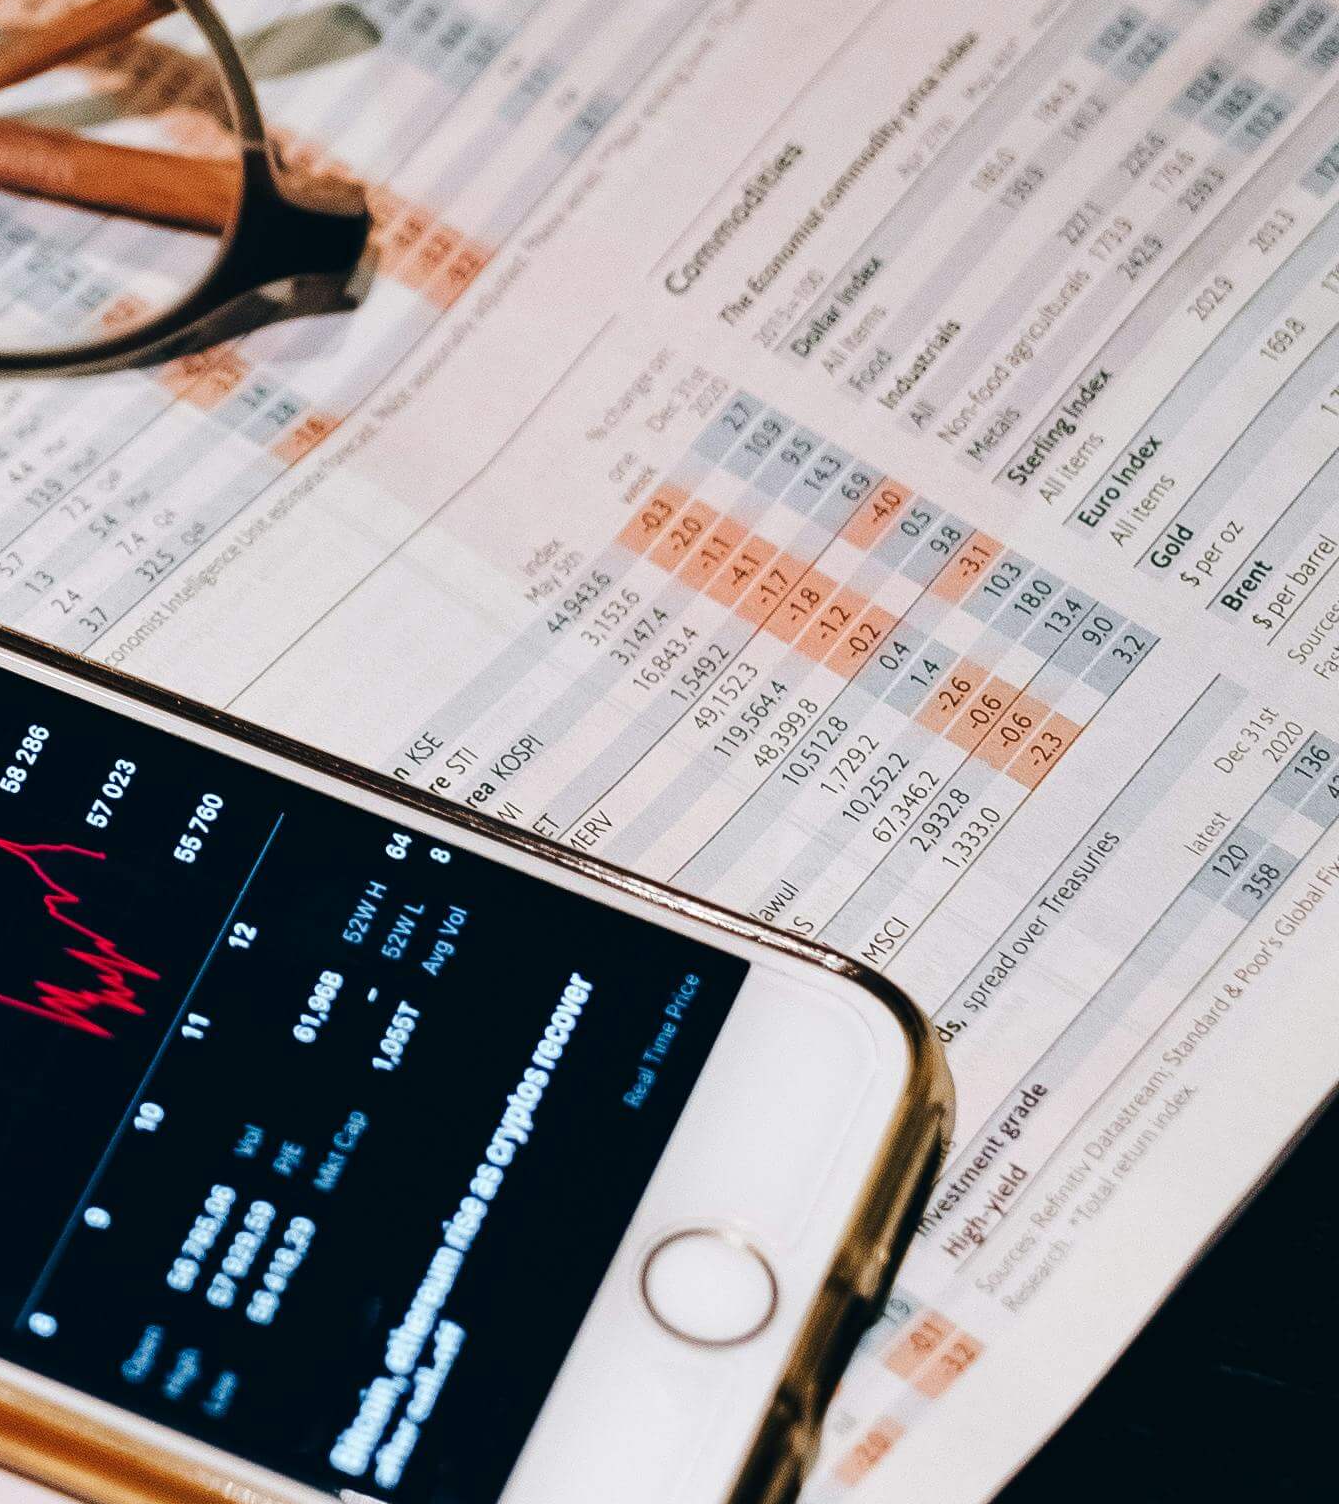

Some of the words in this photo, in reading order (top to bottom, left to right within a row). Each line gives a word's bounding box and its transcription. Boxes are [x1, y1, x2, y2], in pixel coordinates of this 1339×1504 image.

[659, 137, 809, 297] Commodities
[1005, 414, 1075, 488] Sterling
[1062, 365, 1114, 419] Index
[1077, 483, 1122, 530] Euro
[1111, 430, 1164, 486] Index
[1107, 517, 1137, 546] All
[1126, 471, 1177, 523] items
[1147, 521, 1196, 571] Gold
[1178, 567, 1202, 591] $
[1194, 541, 1230, 577] per
[1217, 517, 1245, 545] oz
[632, 622, 701, 695] 16,843.4
[724, 549, 762, 588] -4.1
[669, 640, 732, 706] 1,549.2
[753, 567, 791, 606] -1.7
[838, 469, 872, 503] 6.9
[690, 659, 761, 733] 49,152.3
[783, 584, 822, 624] -1.8
[864, 486, 902, 525] -4.0
[713, 677, 791, 760] 119,564.4
[812, 602, 852, 642] -1.2
[898, 505, 932, 540] 0.5
[1220, 556, 1275, 614] Brent
[1251, 609, 1275, 633] $
[1264, 583, 1301, 620] per
[1285, 531, 1339, 588] barrel
[491, 730, 543, 784] KOSPI
[612, 605, 672, 668] 3,147.4
[695, 533, 731, 570] -1.1
[750, 696, 821, 770] 48,399.8
[842, 619, 882, 661] -0.2
[928, 523, 963, 558] 9.8
[779, 713, 851, 789] 10,512.8
[877, 638, 911, 673] 0.4
[954, 543, 991, 580] -3.1
[818, 731, 883, 799] 1,729.2
[908, 656, 941, 689] 1.4
[982, 559, 1022, 601] 10.3
[840, 749, 913, 825] 10,252.2
[933, 673, 972, 714] -2.6
[1012, 576, 1054, 619] 18.0
[14, 722, 51, 767] 286
[406, 728, 444, 767] KSE
[445, 743, 478, 777] STI
[869, 767, 943, 845] 67,346.2
[963, 691, 1003, 732] -0.6
[1043, 595, 1084, 637] 13.4
[908, 786, 974, 855] 2,932.8
[994, 709, 1034, 750] -0.6
[1079, 612, 1114, 648] 9.0
[1213, 736, 1251, 776] Dec
[1239, 703, 1280, 744] 31st
[85, 798, 116, 830] 57
[101, 756, 139, 801] 023
[171, 831, 203, 865] 55
[187, 790, 226, 837] 760
[860, 913, 910, 966] MSCI
[939, 804, 1004, 872] 1,333.0
[1024, 728, 1064, 769] -2.3
[1112, 630, 1146, 664] 3.2
[1184, 807, 1233, 857] latest
[1261, 718, 1305, 765] 2020
[289, 968, 349, 1046] 61,96B
[341, 899, 380, 945] 52W
[365, 878, 388, 900] H
[383, 829, 414, 862] 64
[380, 915, 418, 961] 52W
[404, 897, 426, 917] L
[428, 844, 453, 866] 8
[419, 937, 455, 977] Avg
[436, 903, 469, 939] Vol
[955, 949, 1022, 1017] spread
[1009, 915, 1049, 956] over
[1038, 828, 1122, 917] Treasuries
[993, 1077, 1055, 1141] grade
[1210, 840, 1250, 882] 120
[1292, 742, 1332, 783] 136
[130, 1097, 167, 1136] 10
[178, 1009, 211, 1044] 11
[225, 918, 259, 953] 12
[368, 1000, 426, 1075] 1,055T
[526, 972, 599, 1070] recover
[620, 1064, 658, 1110] Real
[641, 1019, 679, 1067] Time
[663, 970, 703, 1020] Price
[939, 1161, 1037, 1264] High-yield
[1241, 859, 1282, 901] 358
[478, 1063, 560, 1169] cryptos
[436, 1191, 491, 1252] rise
[466, 1159, 507, 1202] as
